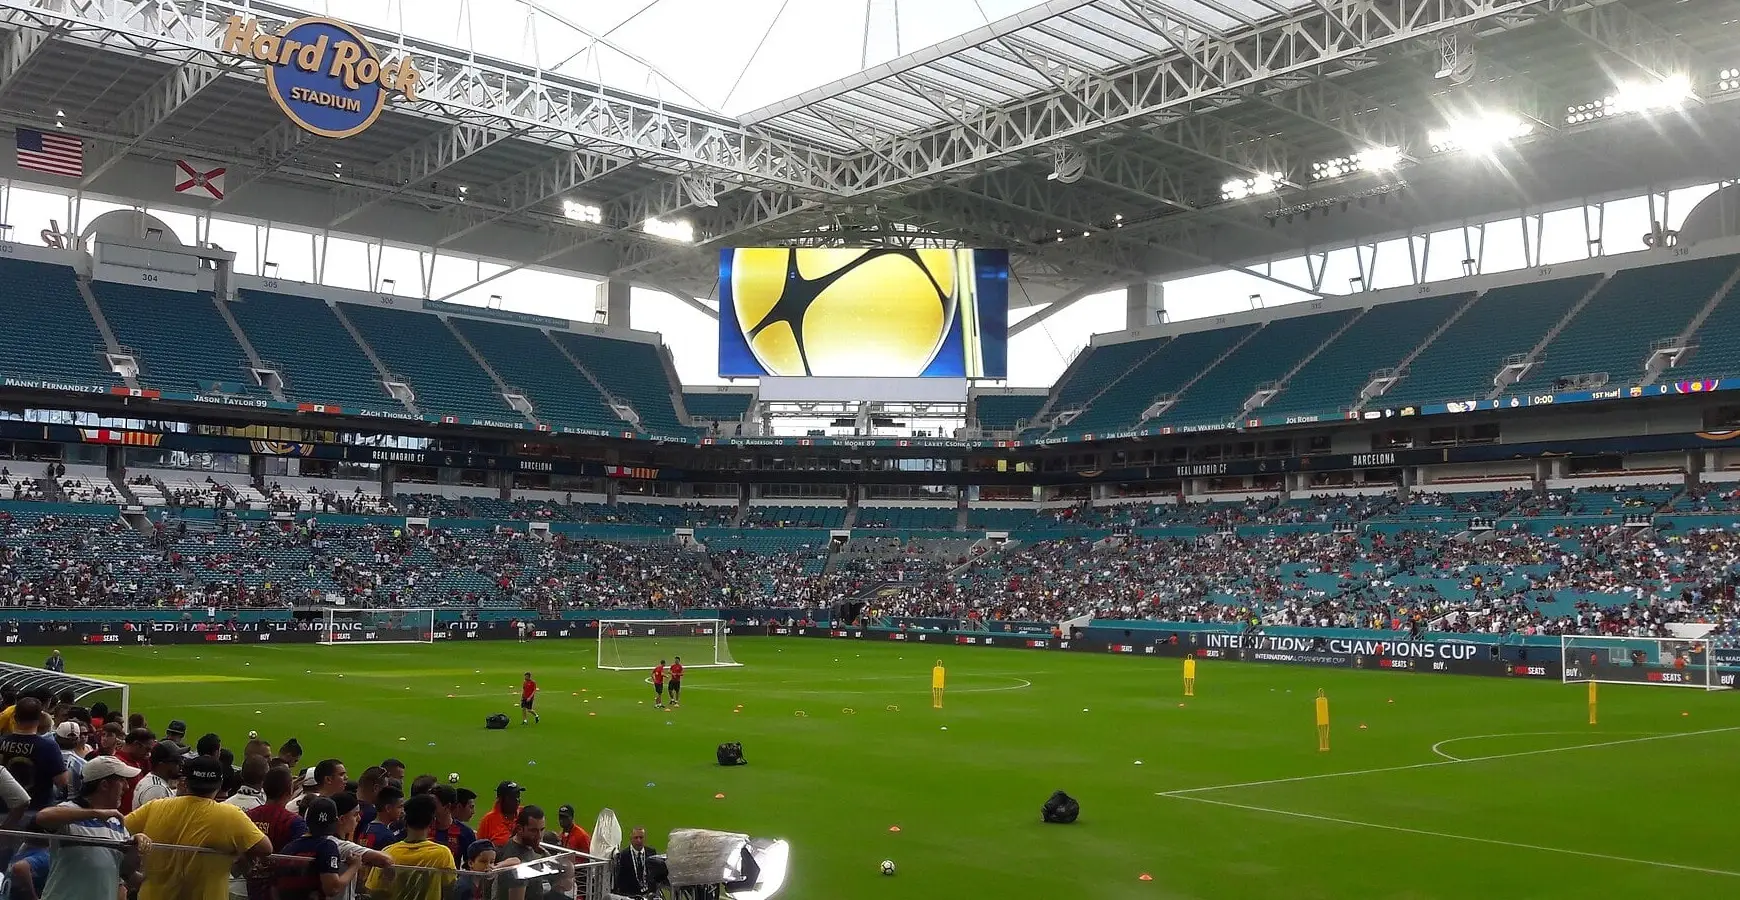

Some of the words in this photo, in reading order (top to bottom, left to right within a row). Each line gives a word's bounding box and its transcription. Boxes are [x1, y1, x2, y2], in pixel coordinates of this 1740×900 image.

[222, 14, 329, 73] Hard
[329, 39, 422, 102] Rock
[291, 86, 361, 112] STADIUM
[142, 273, 158, 282] 304
[263, 280, 278, 289] 305
[4, 378, 39, 388] MANNY
[92, 385, 104, 394] 75
[1660, 384, 1667, 394] 0
[193, 394, 220, 404] JASON
[224, 398, 253, 406] TAYLOR
[256, 400, 267, 408] 99
[1534, 395, 1554, 404] 0:00
[372, 451, 388, 461] REAL
[390, 452, 415, 462] MADRID
[417, 453, 425, 462] CF
[1353, 453, 1395, 466] BARCELONA
[1177, 465, 1191, 476] REAL
[1193, 464, 1217, 475] MADRID
[1219, 463, 1227, 474] CF
[6, 634, 19, 643] BUY
[1207, 633, 1326, 652] INTENTION
[1439, 644, 1477, 660] CUP
[1433, 661, 1444, 670] BUY
[1566, 668, 1578, 677] BUY
[1721, 675, 1735, 685] BUY
[0, 740, 35, 755] MESSI
